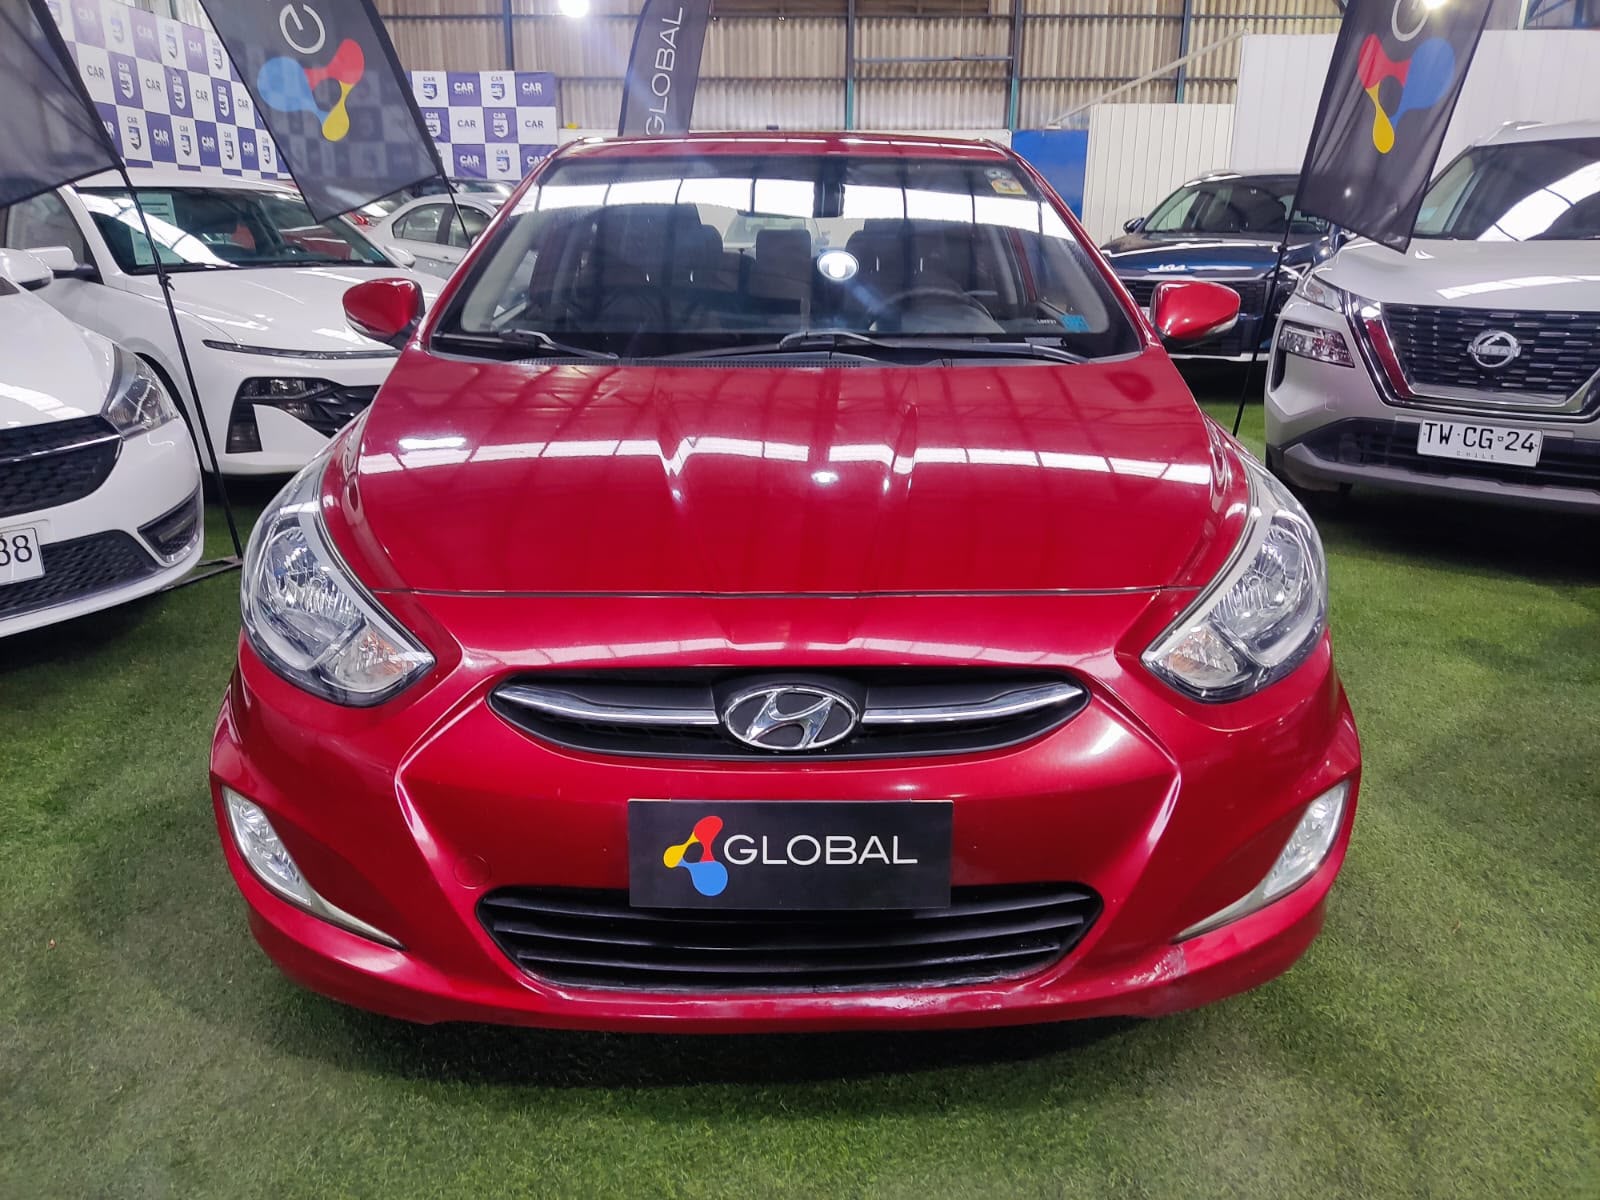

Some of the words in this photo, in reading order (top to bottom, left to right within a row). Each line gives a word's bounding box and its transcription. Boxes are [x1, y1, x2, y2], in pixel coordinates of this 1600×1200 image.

[86, 65, 105, 80] CAR
[645, 7, 683, 135] GLOBAL
[145, 78, 161, 92] CAR
[454, 82, 474, 92] CAR
[522, 82, 542, 92] CAR
[195, 90, 208, 101] CAR
[237, 98, 249, 109] CAR
[457, 120, 477, 128] CAR
[525, 120, 544, 128] CAR
[153, 128, 169, 144] CAR
[202, 136, 215, 149] CAR
[460, 155, 480, 164] CAR
[723, 834, 918, 866] GLOBAL
